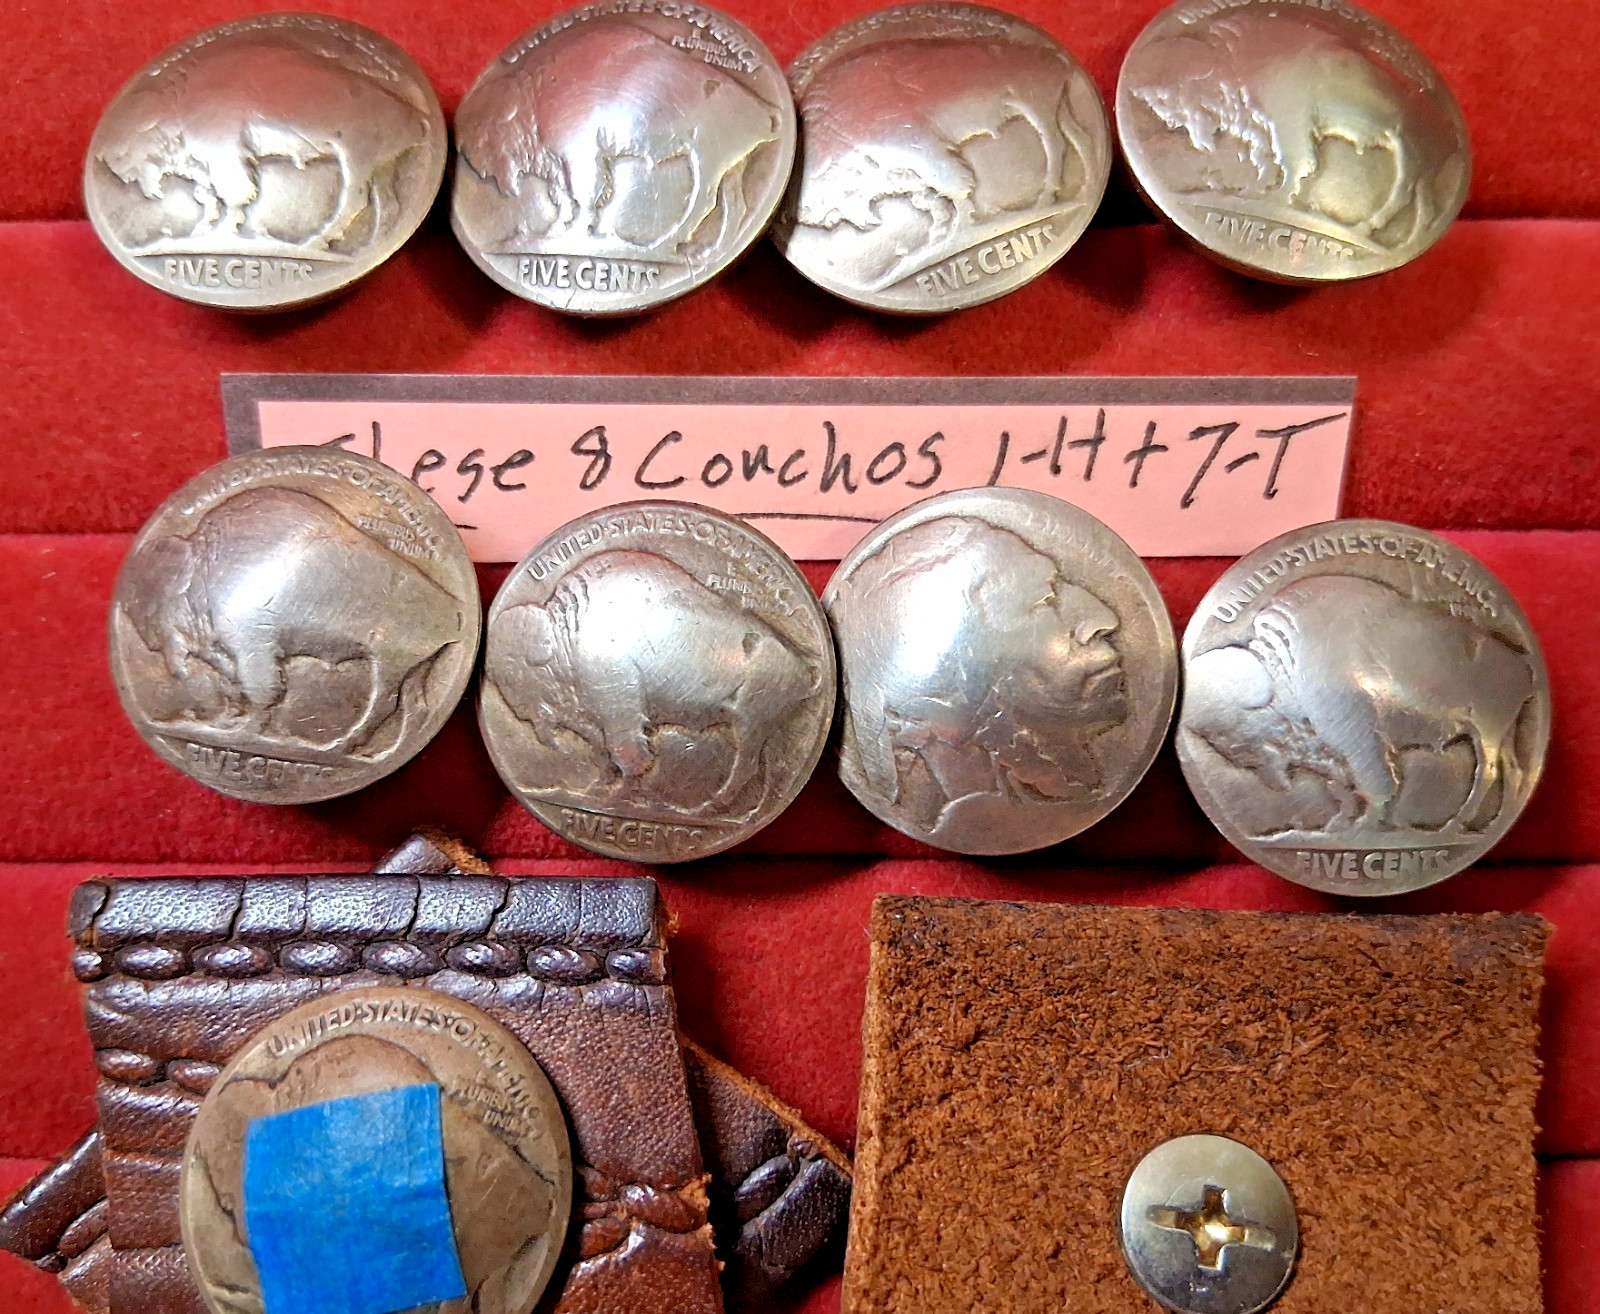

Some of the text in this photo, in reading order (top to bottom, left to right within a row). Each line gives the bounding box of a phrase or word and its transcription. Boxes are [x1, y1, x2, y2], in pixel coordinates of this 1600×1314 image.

[163, 258, 315, 290] FIVE CENTS
[518, 256, 660, 295] FIVE CENTS
[915, 224, 1054, 298] FIVE CENTS
[570, 425, 612, 492] 8
[1123, 420, 1169, 488] +
[1180, 412, 1348, 510] 7-T
[527, 526, 605, 582] UNITED
[609, 511, 691, 538] STATES
[1211, 558, 1290, 624] UNITED
[1293, 533, 1376, 568] STATES
[1294, 849, 1450, 880] FIVE CENTS
[265, 1001, 358, 1057] UNITED
[362, 999, 448, 1032] STATES
